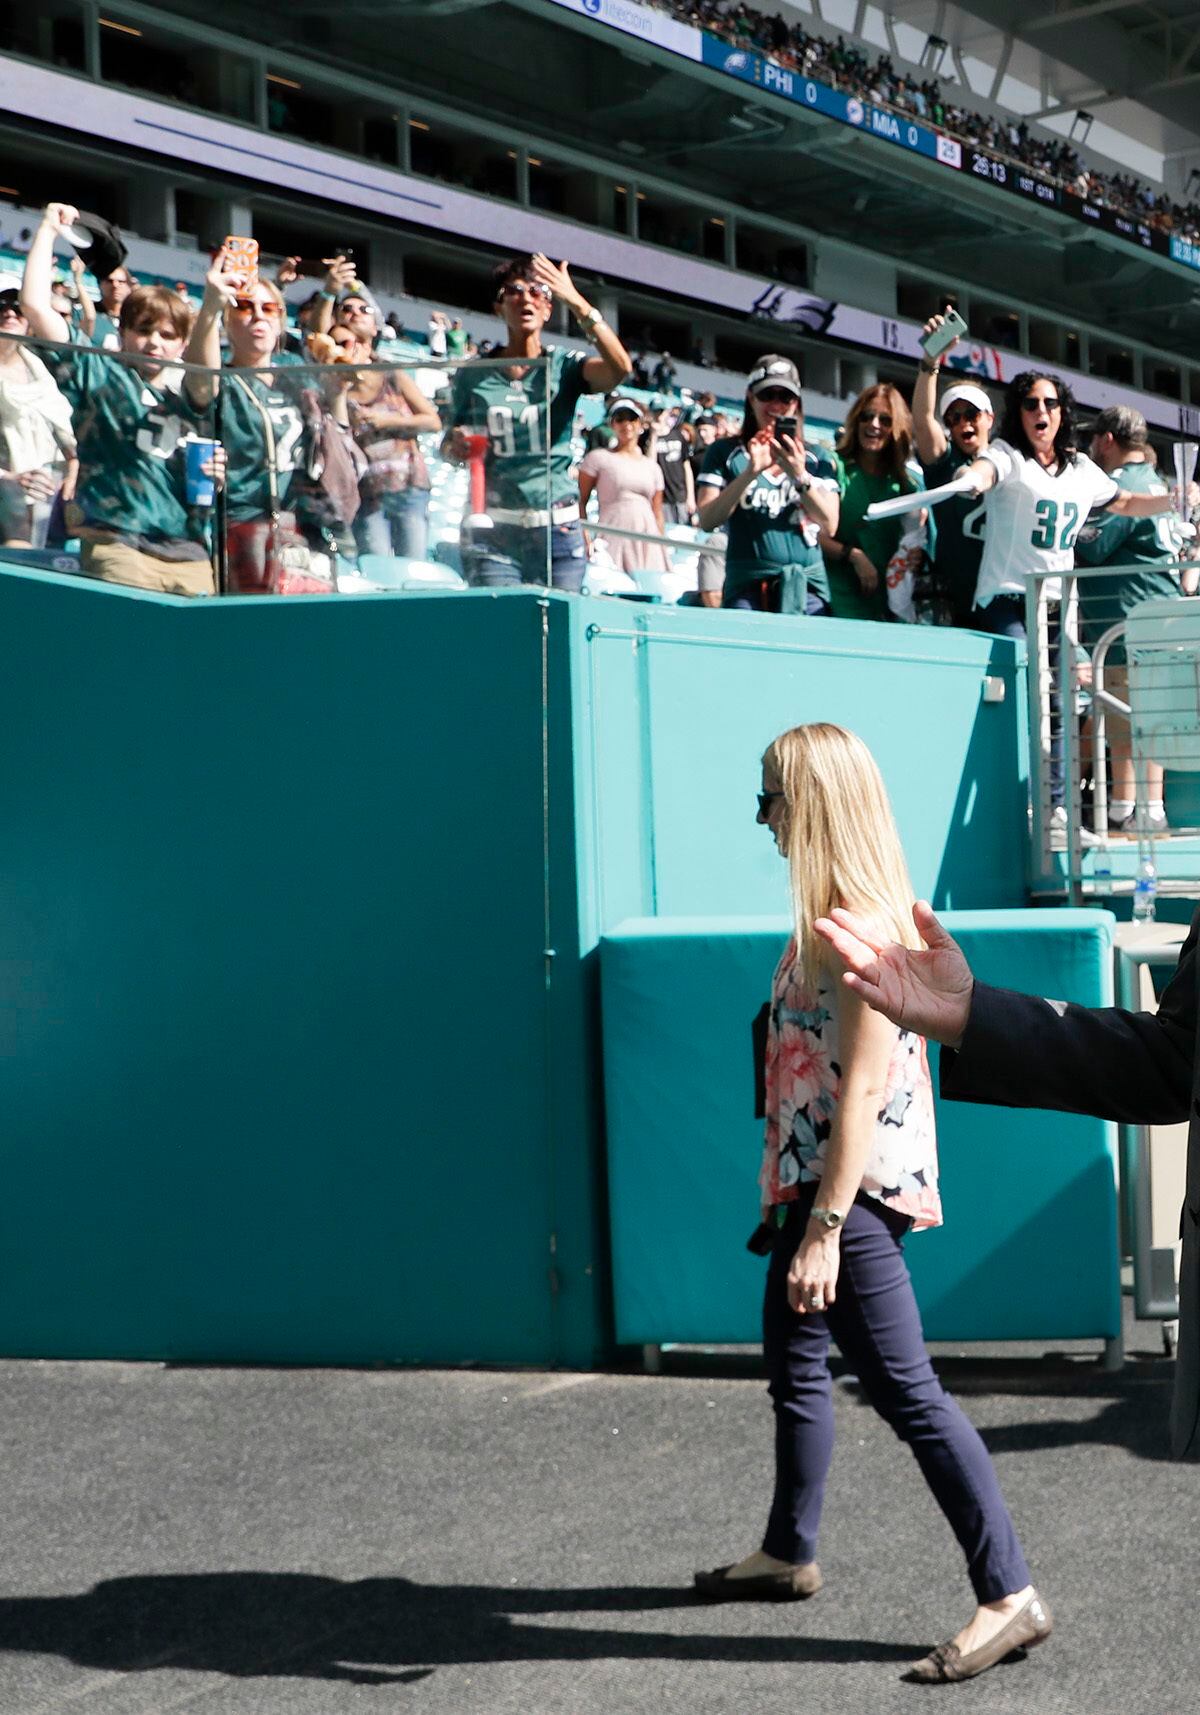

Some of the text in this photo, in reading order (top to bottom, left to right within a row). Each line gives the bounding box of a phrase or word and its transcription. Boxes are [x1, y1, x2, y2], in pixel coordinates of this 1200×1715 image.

[764, 64, 817, 104] PHI 0
[872, 109, 918, 146] MIA 0
[971, 153, 1007, 183] 26:13
[486, 405, 546, 458] 91
[1030, 498, 1080, 551] 32
